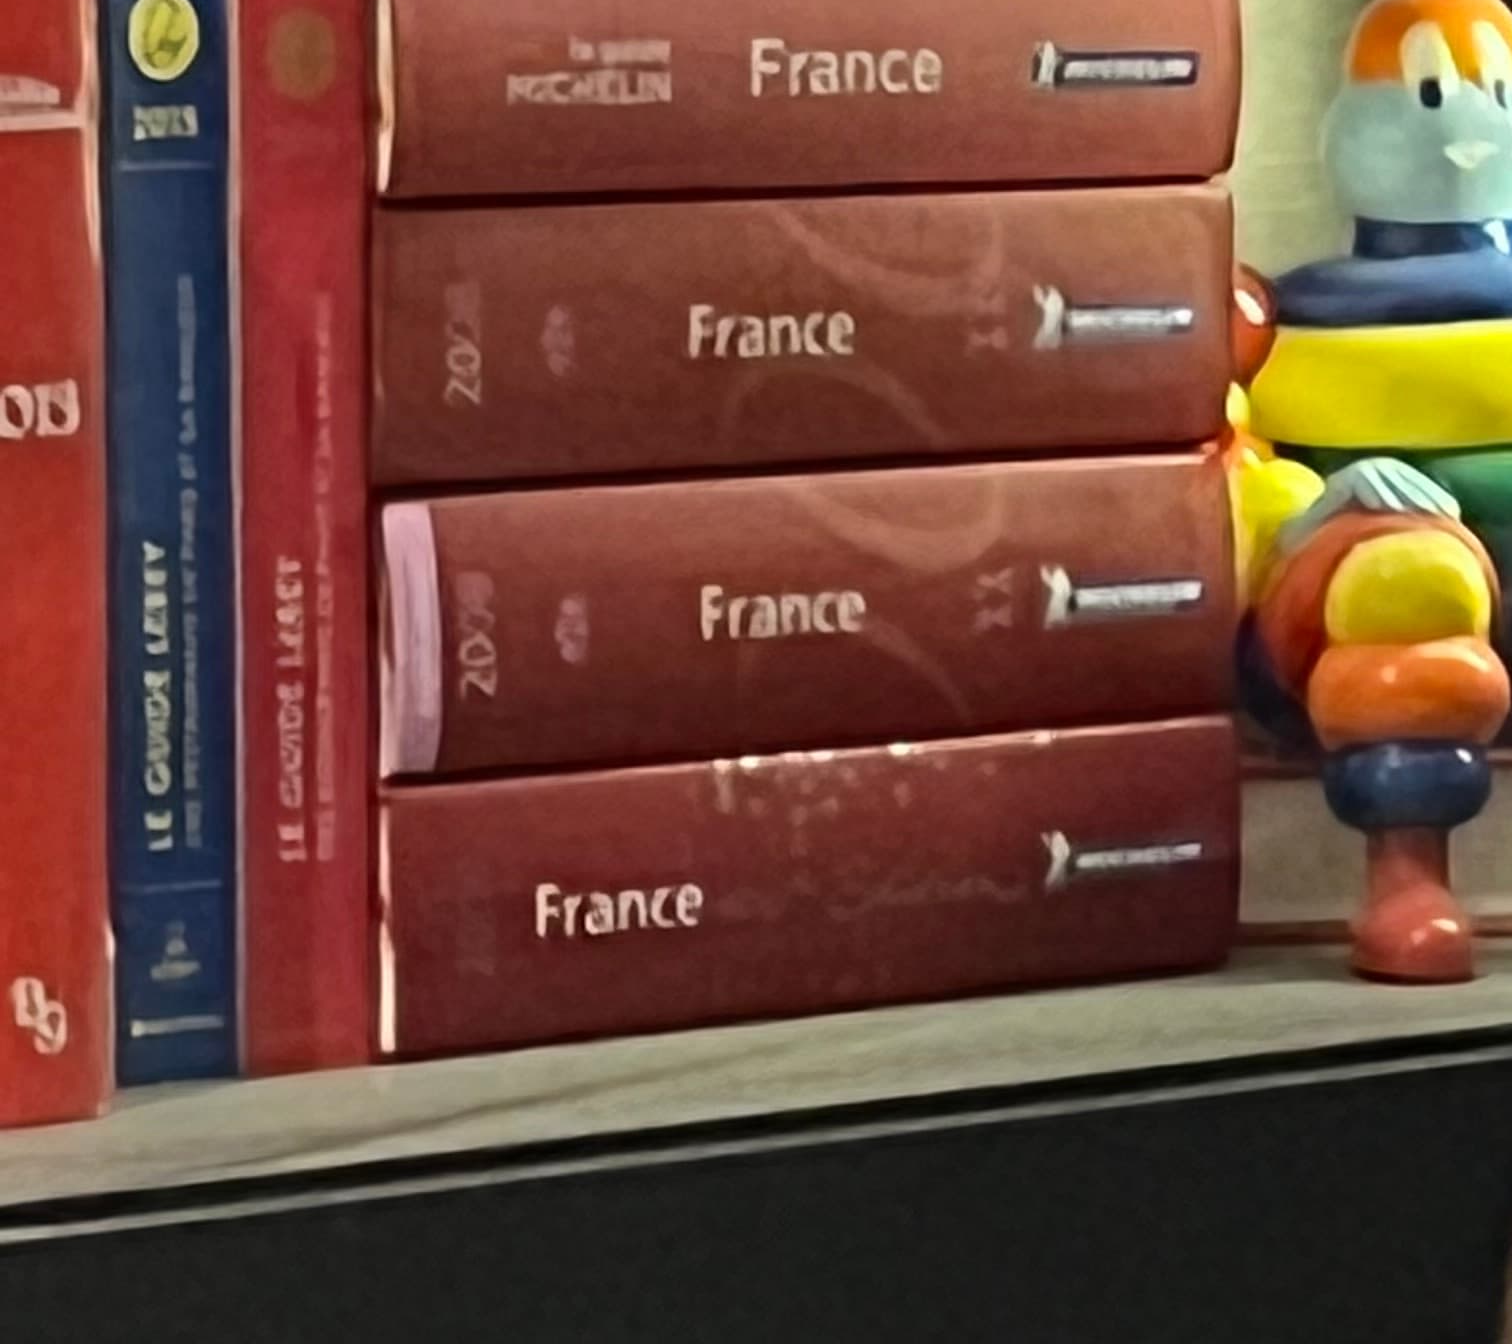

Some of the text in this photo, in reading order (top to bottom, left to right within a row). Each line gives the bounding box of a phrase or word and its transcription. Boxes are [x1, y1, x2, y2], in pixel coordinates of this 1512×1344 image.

[749, 37, 943, 97] France
[687, 303, 855, 360] France
[700, 583, 867, 641] France
[535, 882, 704, 939] France
